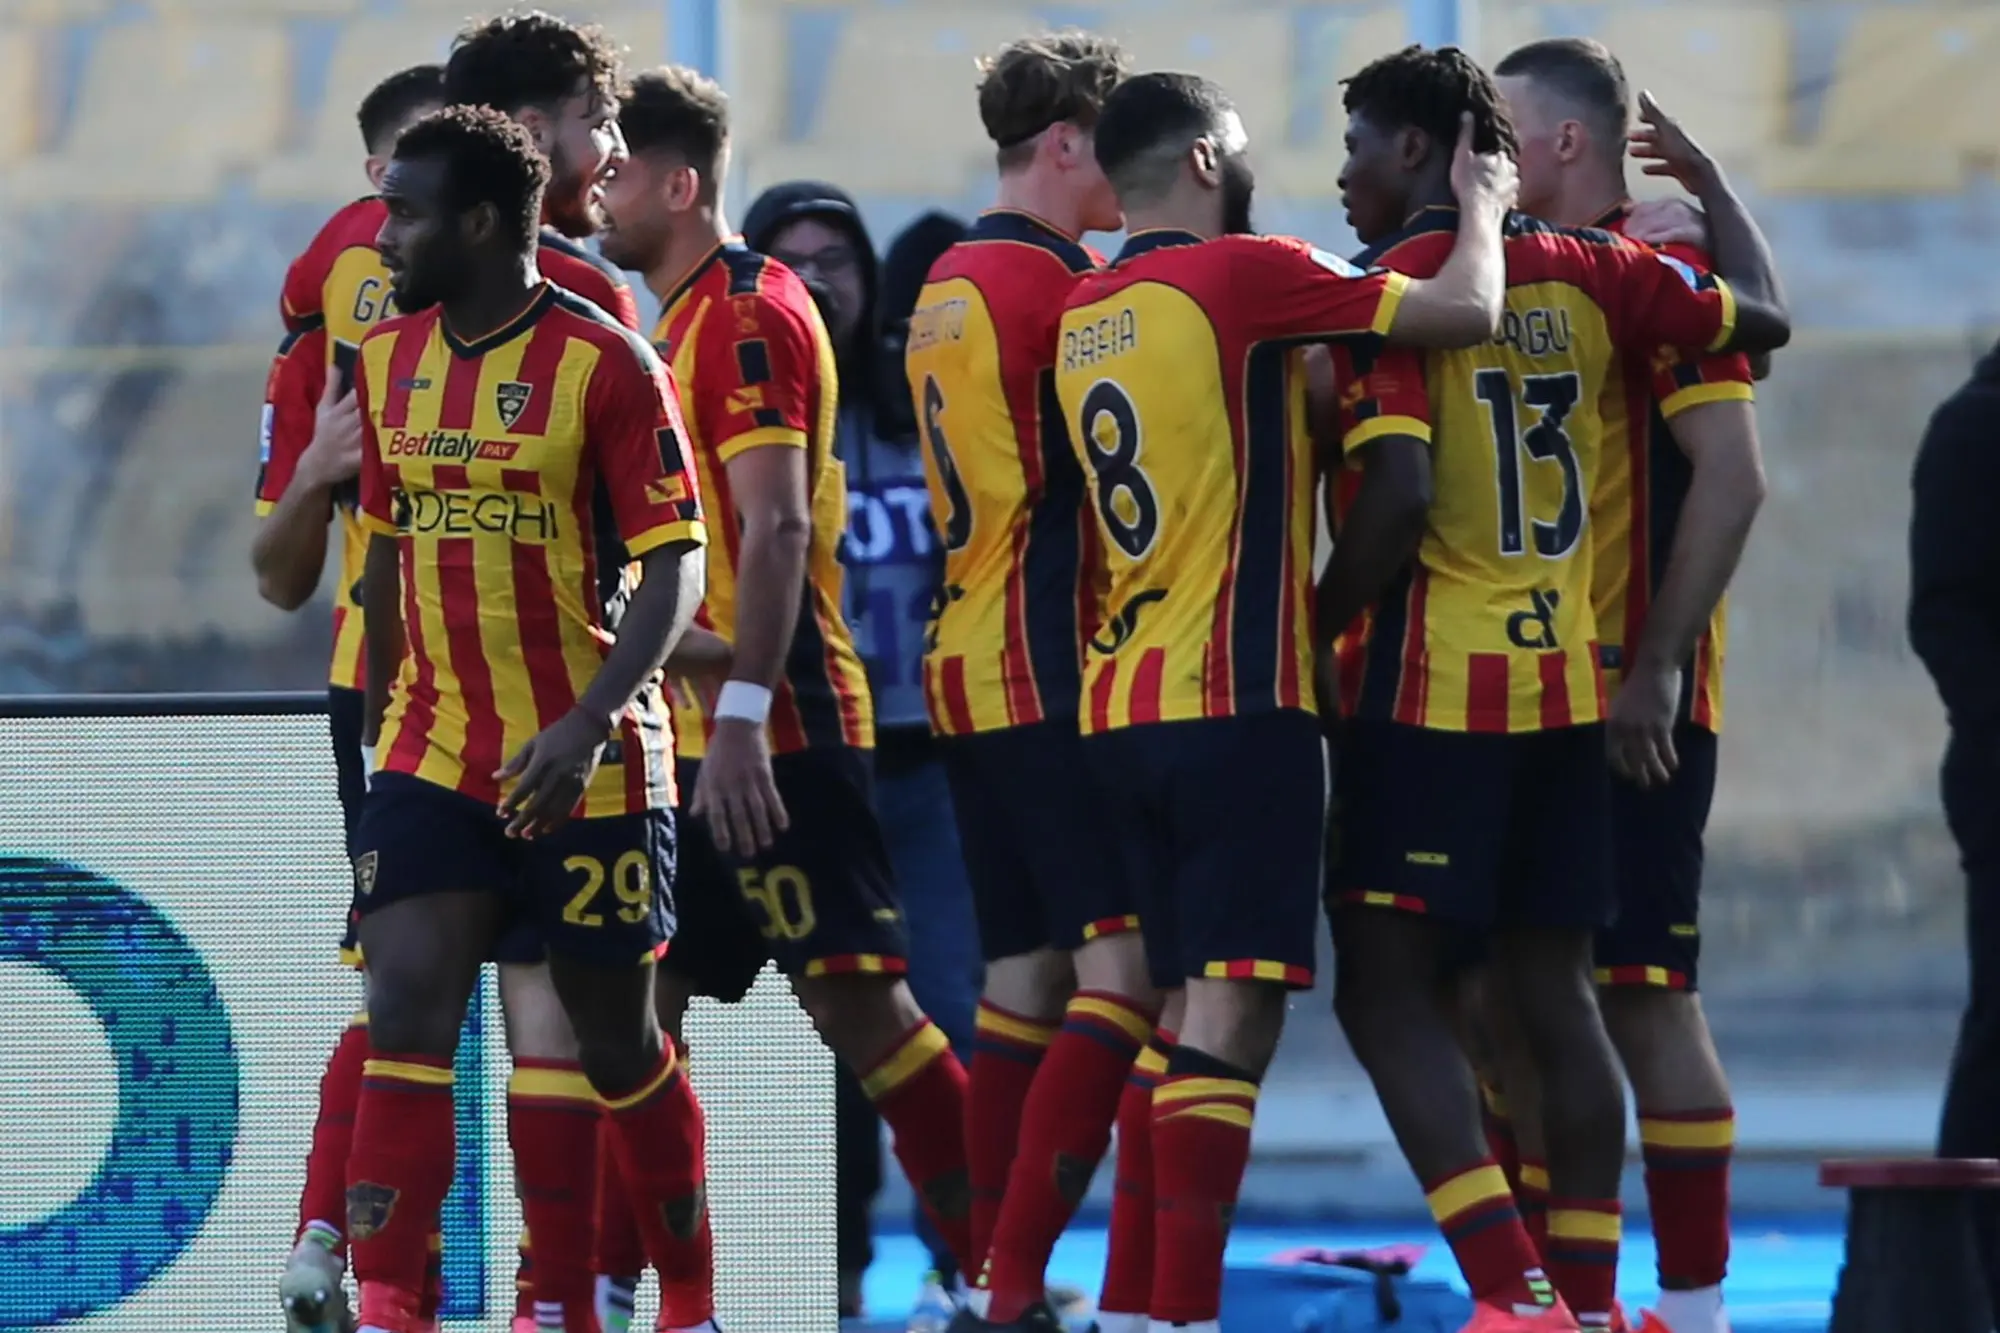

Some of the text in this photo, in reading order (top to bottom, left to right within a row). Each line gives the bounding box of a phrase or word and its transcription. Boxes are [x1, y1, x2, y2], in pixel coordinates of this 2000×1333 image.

[1064, 308, 1135, 373] RAFIA
[388, 430, 511, 464] Betitaly PAY
[1080, 377, 1160, 561] 8
[1474, 368, 1586, 559] 13
[413, 490, 558, 539] DEGHI
[563, 849, 652, 926] 29
[736, 865, 816, 939] 50
